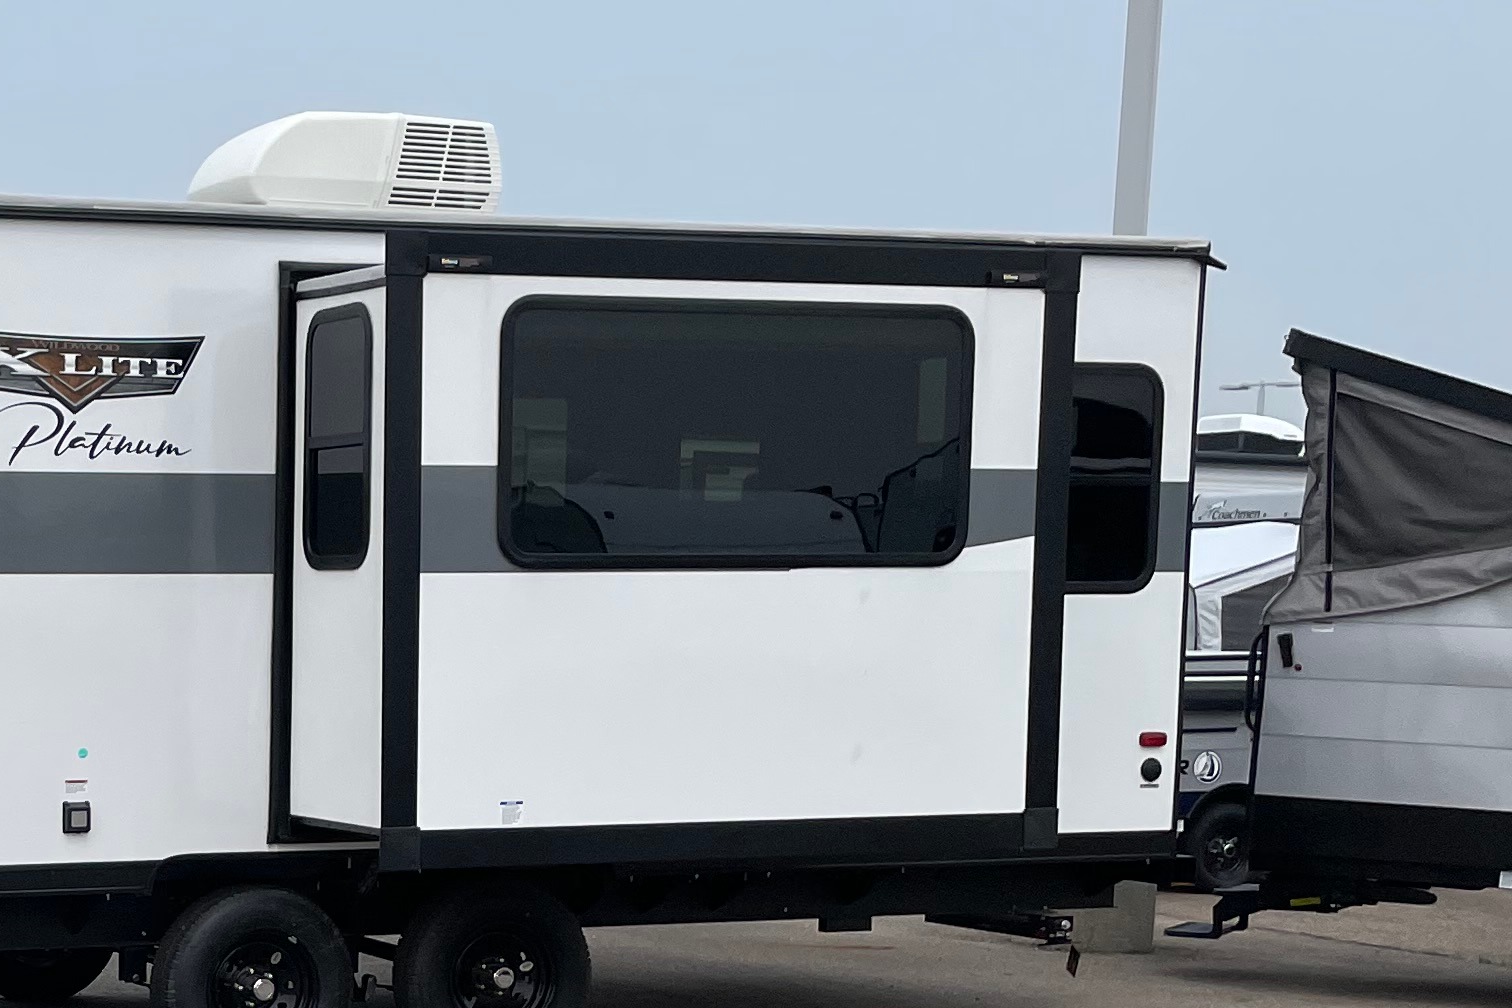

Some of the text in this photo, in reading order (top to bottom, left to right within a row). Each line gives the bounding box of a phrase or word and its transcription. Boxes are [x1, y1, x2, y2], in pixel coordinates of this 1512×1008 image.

[32, 339, 120, 352] WILDWOOD
[59, 352, 185, 379] LITE
[1211, 508, 1261, 520] Coachmen
